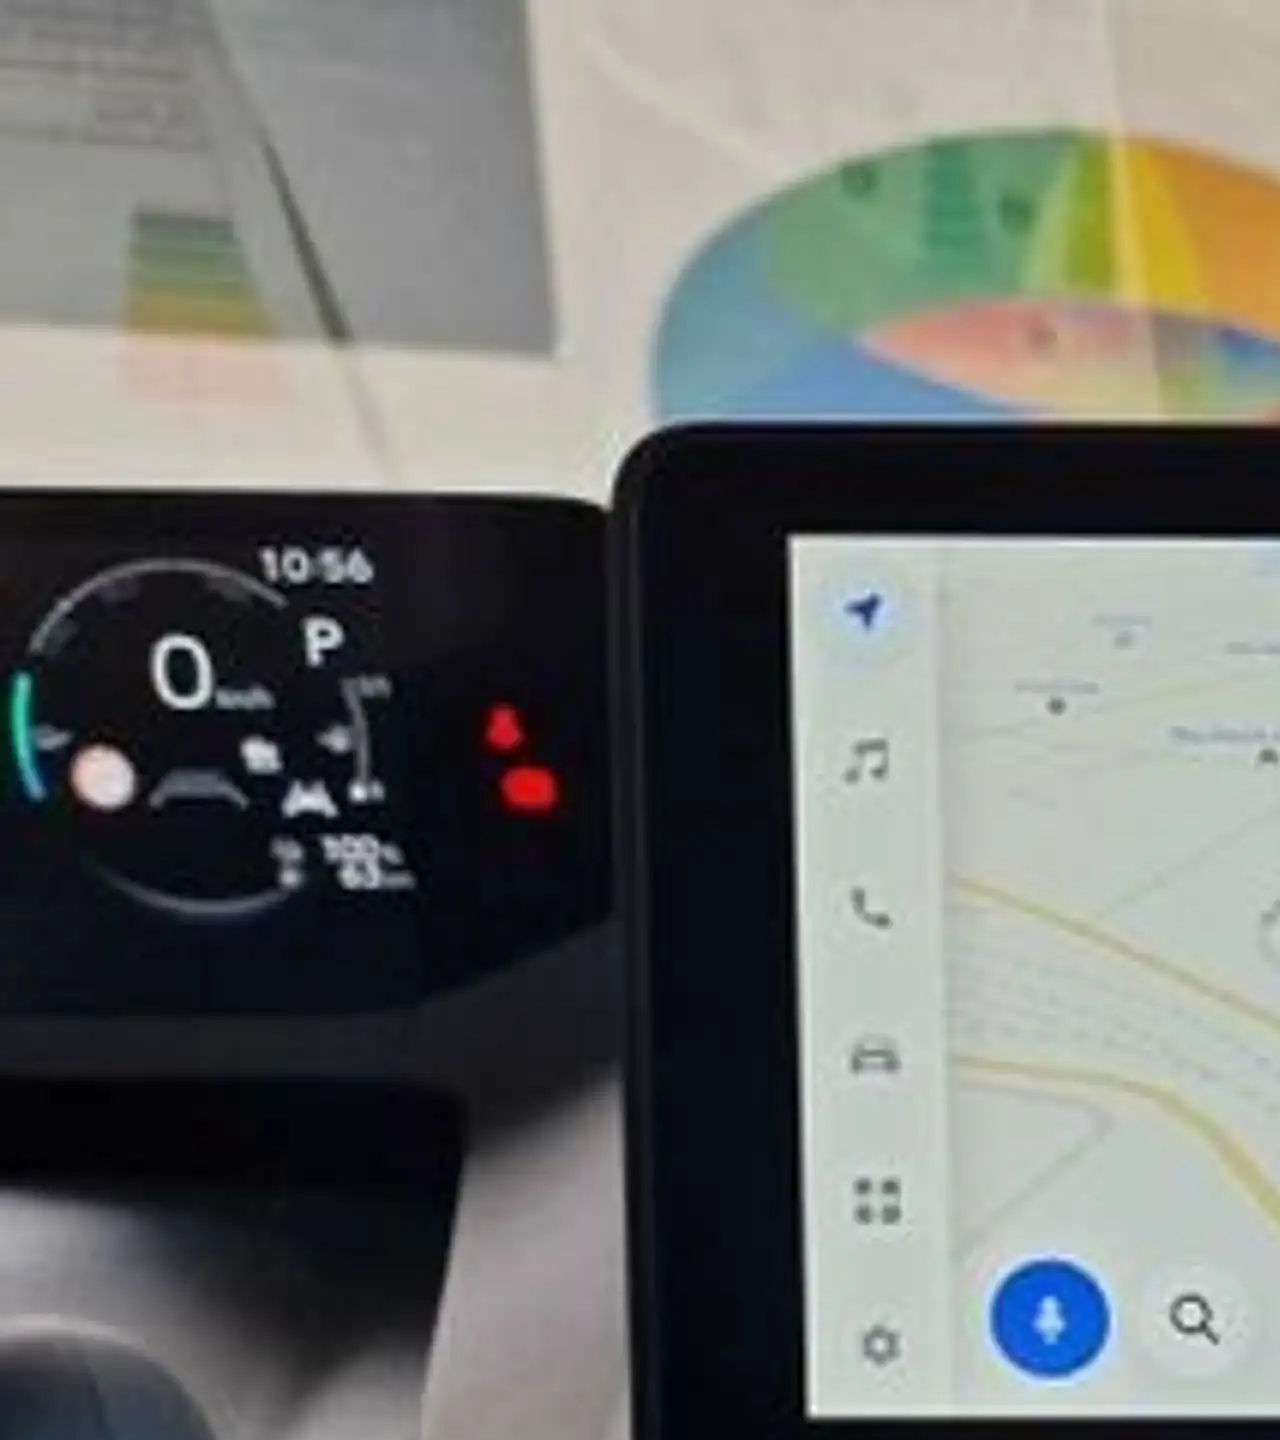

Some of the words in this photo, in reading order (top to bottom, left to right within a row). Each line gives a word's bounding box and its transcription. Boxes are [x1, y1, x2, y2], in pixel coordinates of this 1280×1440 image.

[258, 546, 375, 585] 10:56
[301, 615, 346, 668] P
[150, 632, 215, 711] 0
